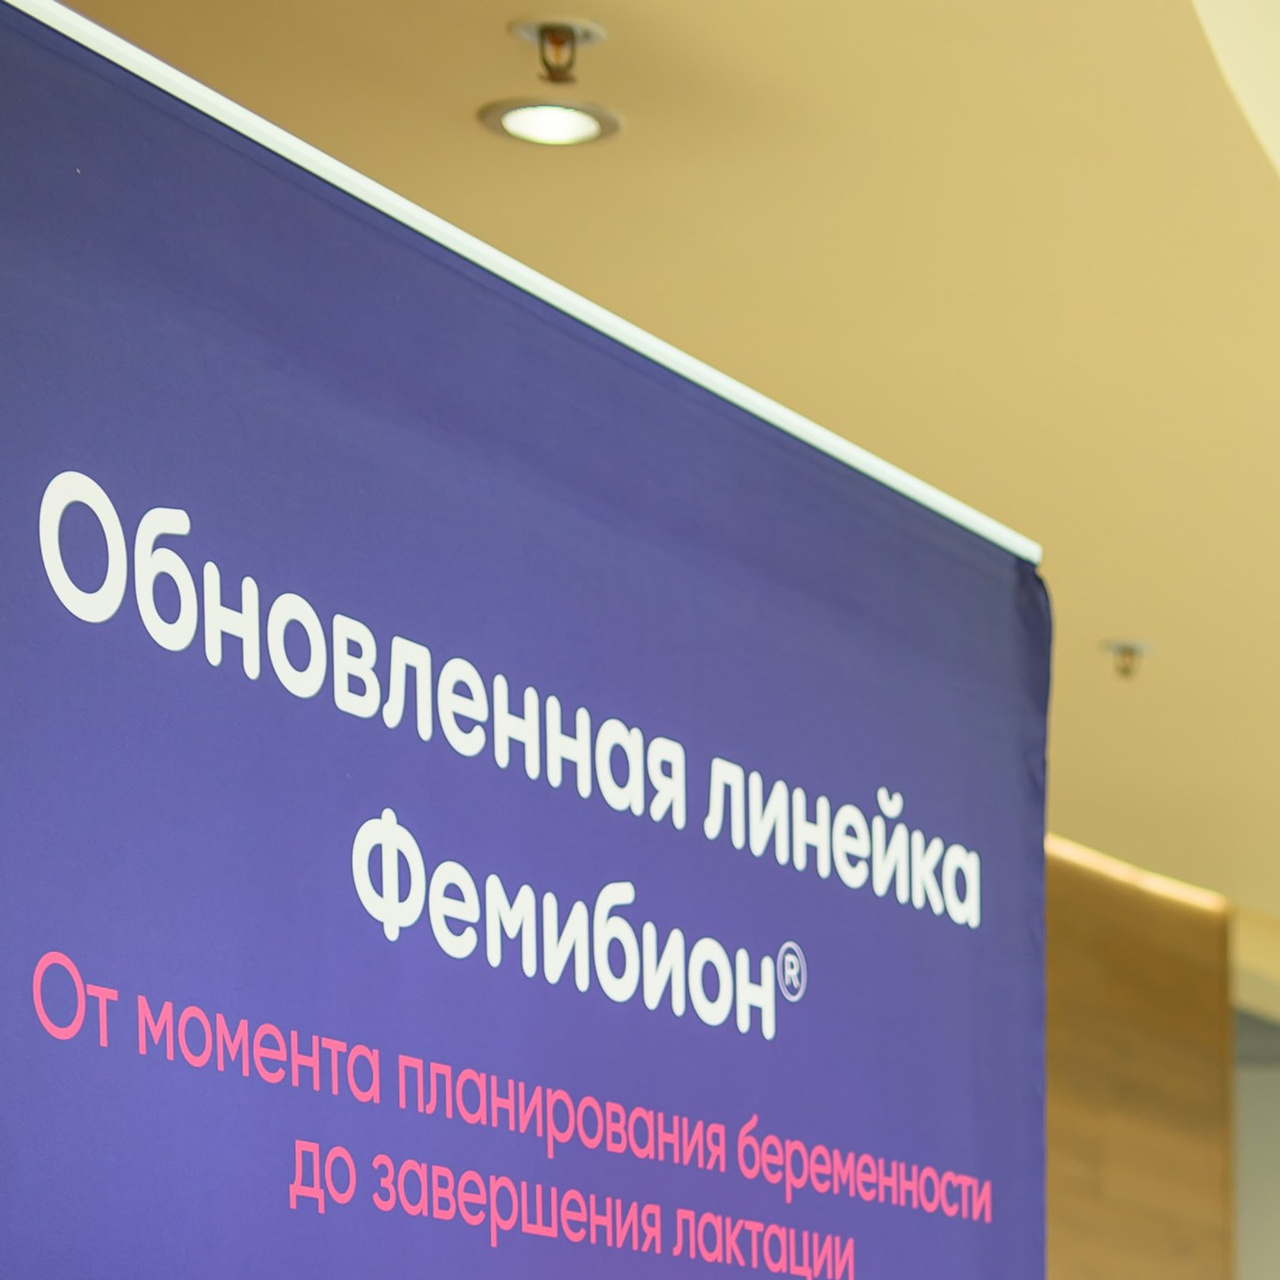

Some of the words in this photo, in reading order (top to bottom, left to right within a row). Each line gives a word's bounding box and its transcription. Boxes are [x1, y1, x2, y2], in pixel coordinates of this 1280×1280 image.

[39, 470, 687, 832] Обновленная
[703, 756, 982, 928] линейка
[32, 950, 118, 1047] От
[137, 993, 381, 1104] момента
[397, 1052, 727, 1172] планирования
[737, 1113, 993, 1223] беременности
[288, 1137, 357, 1213] до
[372, 1152, 662, 1255] завершения
